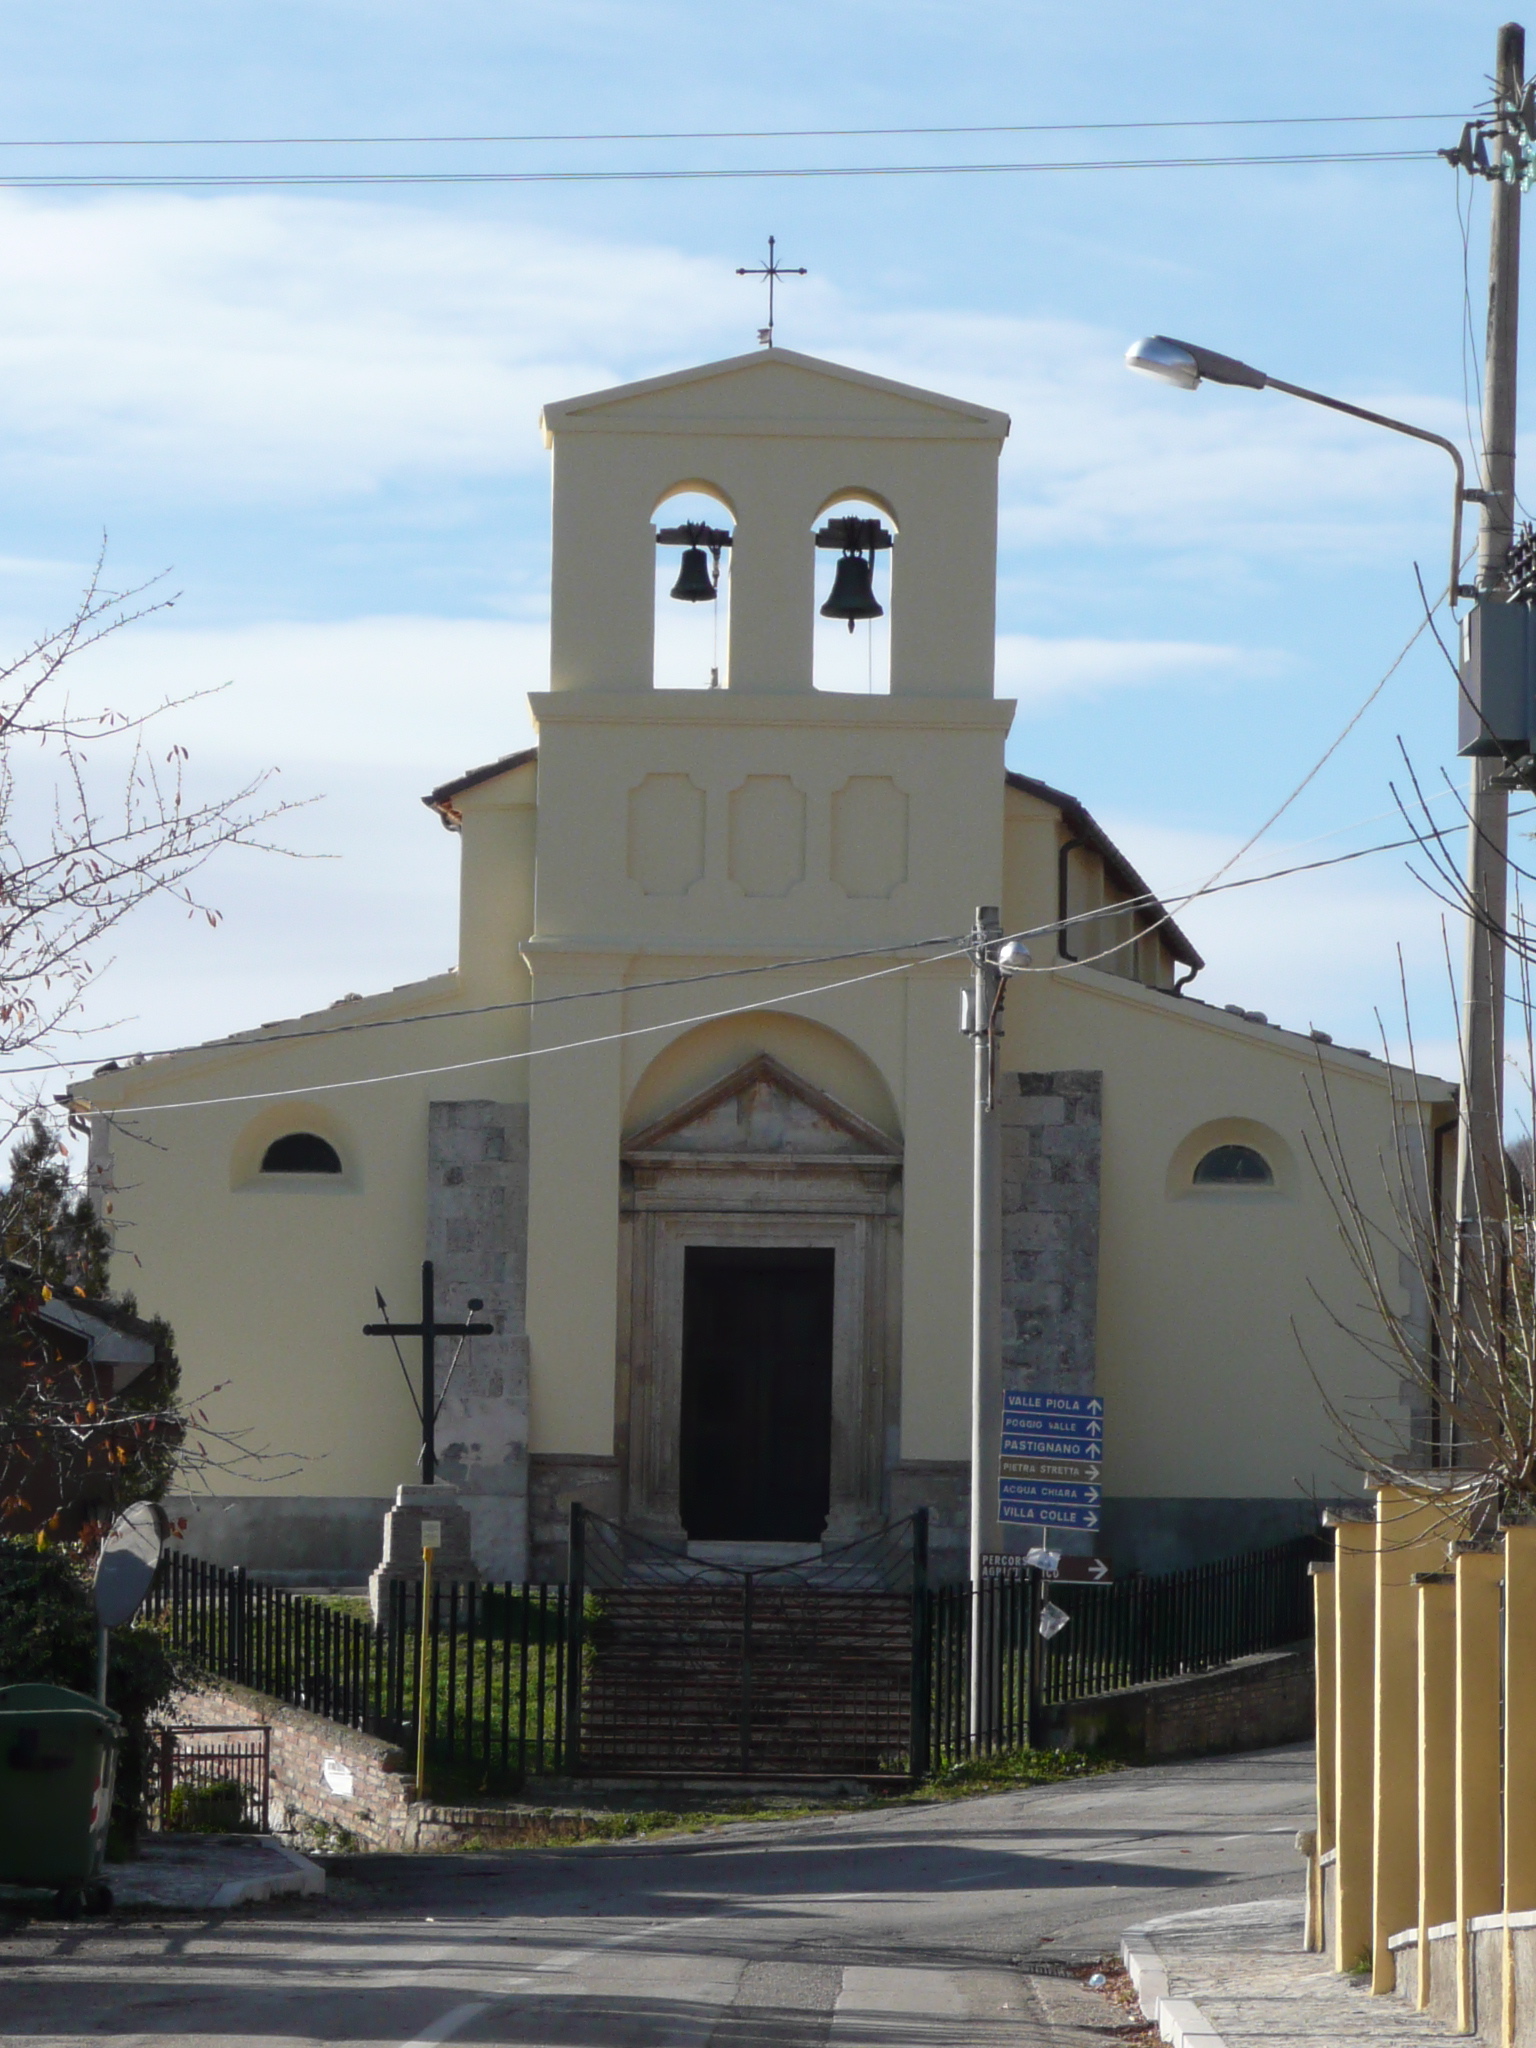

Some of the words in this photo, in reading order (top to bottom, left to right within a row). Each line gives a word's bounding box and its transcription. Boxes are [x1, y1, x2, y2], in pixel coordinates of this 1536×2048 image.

[1009, 1396, 1041, 1408] VALLE
[1046, 1399, 1080, 1411] PIOLA
[1005, 1418, 1042, 1429] POGGIO
[1004, 1440, 1080, 1455] PASTIGNANO
[1003, 1463, 1035, 1473] PIETRA
[1040, 1465, 1080, 1477] STRETTA
[1003, 1485, 1036, 1496] ACQUA
[1041, 1487, 1078, 1498] CHIARA
[1003, 1506, 1035, 1519] VILLA
[1040, 1510, 1077, 1522] COLLE
